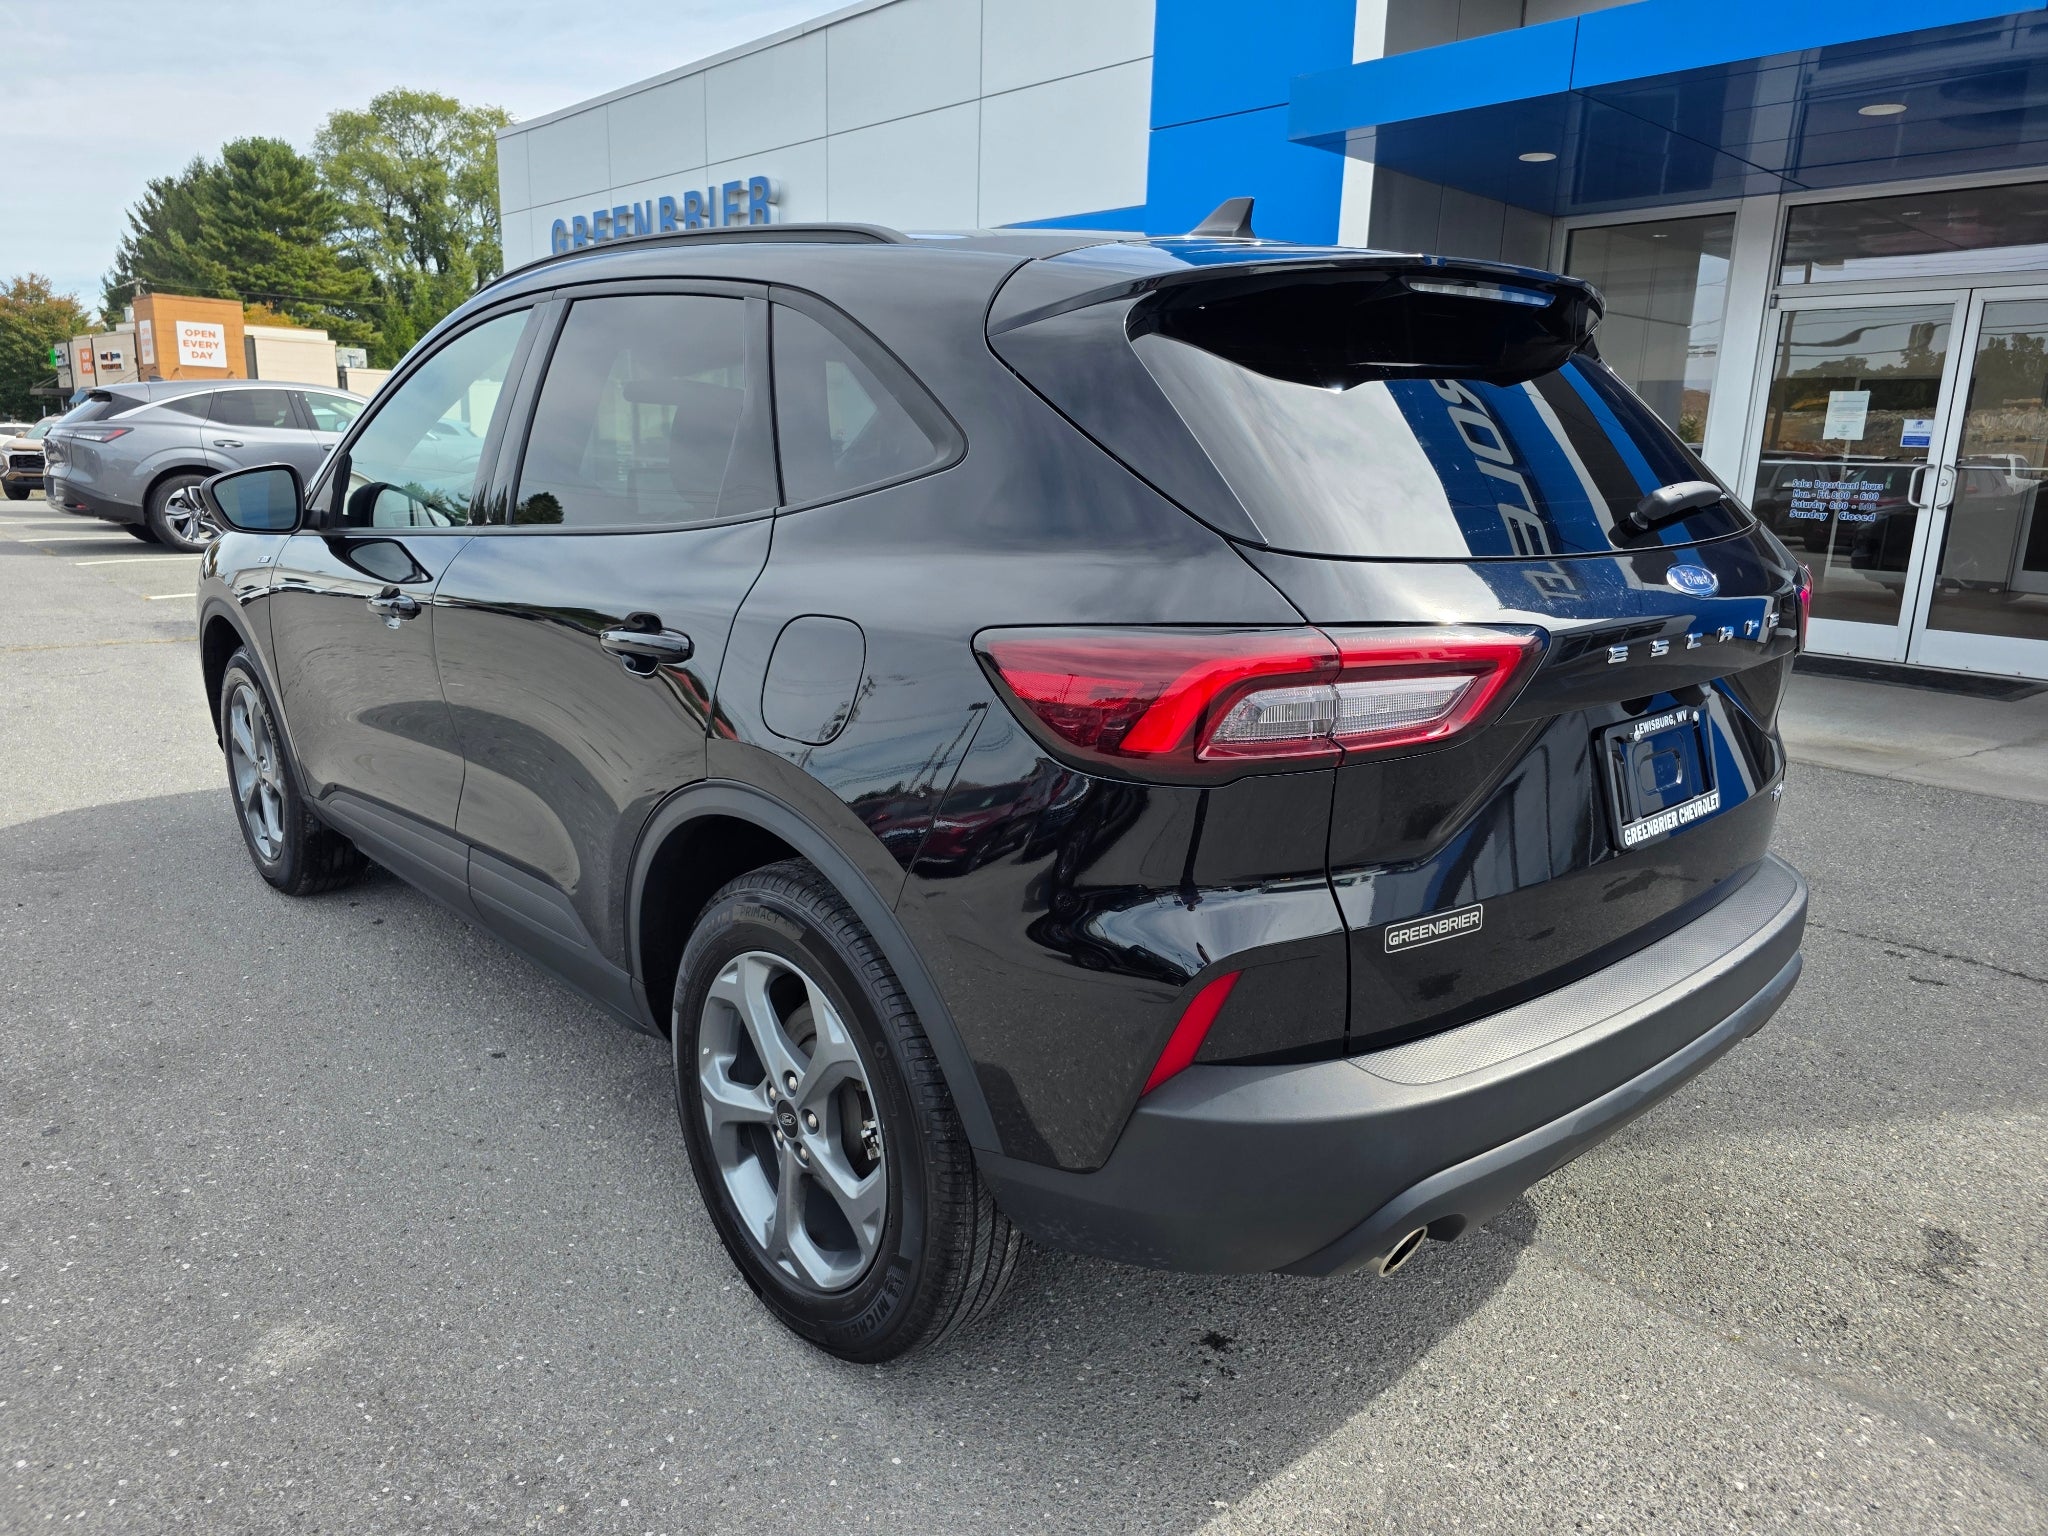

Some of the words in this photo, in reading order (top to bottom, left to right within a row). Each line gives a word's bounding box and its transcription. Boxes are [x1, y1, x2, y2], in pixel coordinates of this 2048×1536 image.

[551, 175, 777, 255] GREENBRIER
[184, 328, 216, 339] OPEN
[182, 339, 220, 350] EVERY
[191, 350, 214, 360] DAY
[1792, 478, 1813, 489] Sales
[1813, 480, 1860, 490] Department
[1860, 481, 1884, 491] Hours
[1792, 489, 1812, 499] Mon.
[1817, 490, 1831, 499] Fri.
[1831, 490, 1850, 500] 8:00
[1859, 491, 1880, 501] 6:00
[1791, 499, 1827, 511] Saturday
[1829, 501, 1849, 510] 8:00
[1789, 509, 1829, 521] Sunday
[1838, 511, 1876, 522] Closed
[1634, 714, 1676, 736] LEWISBURG,
[1676, 709, 1687, 723] WV
[1624, 812, 1679, 846] GREENBRIER
[1678, 792, 1720, 823] CHEVROLET
[739, 904, 781, 923] PRIMACY
[1388, 911, 1480, 946] GREENBRIER
